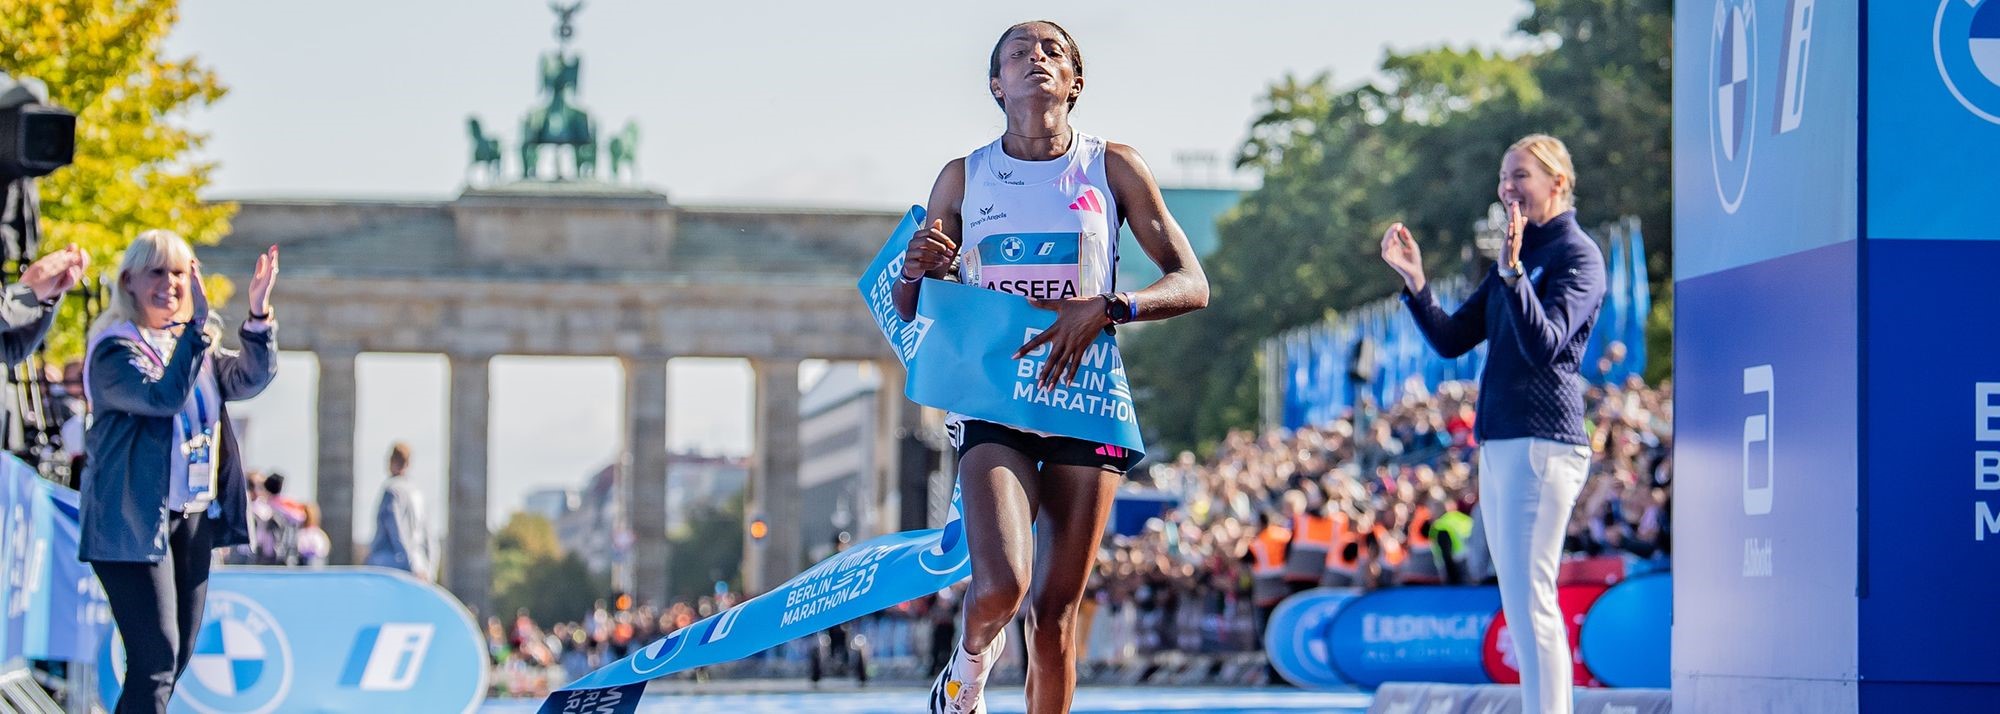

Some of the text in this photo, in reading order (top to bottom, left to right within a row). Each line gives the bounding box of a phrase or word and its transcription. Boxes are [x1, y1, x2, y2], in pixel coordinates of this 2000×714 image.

[986, 212, 1007, 222] Angels
[878, 268, 899, 340] BERLIN
[986, 279, 1078, 299] ASSEFA
[1023, 327, 1109, 369] BW
[1012, 381, 1137, 425] MARATHON
[786, 562, 879, 608] BERLIN 23
[780, 586, 850, 628] MARATHON
